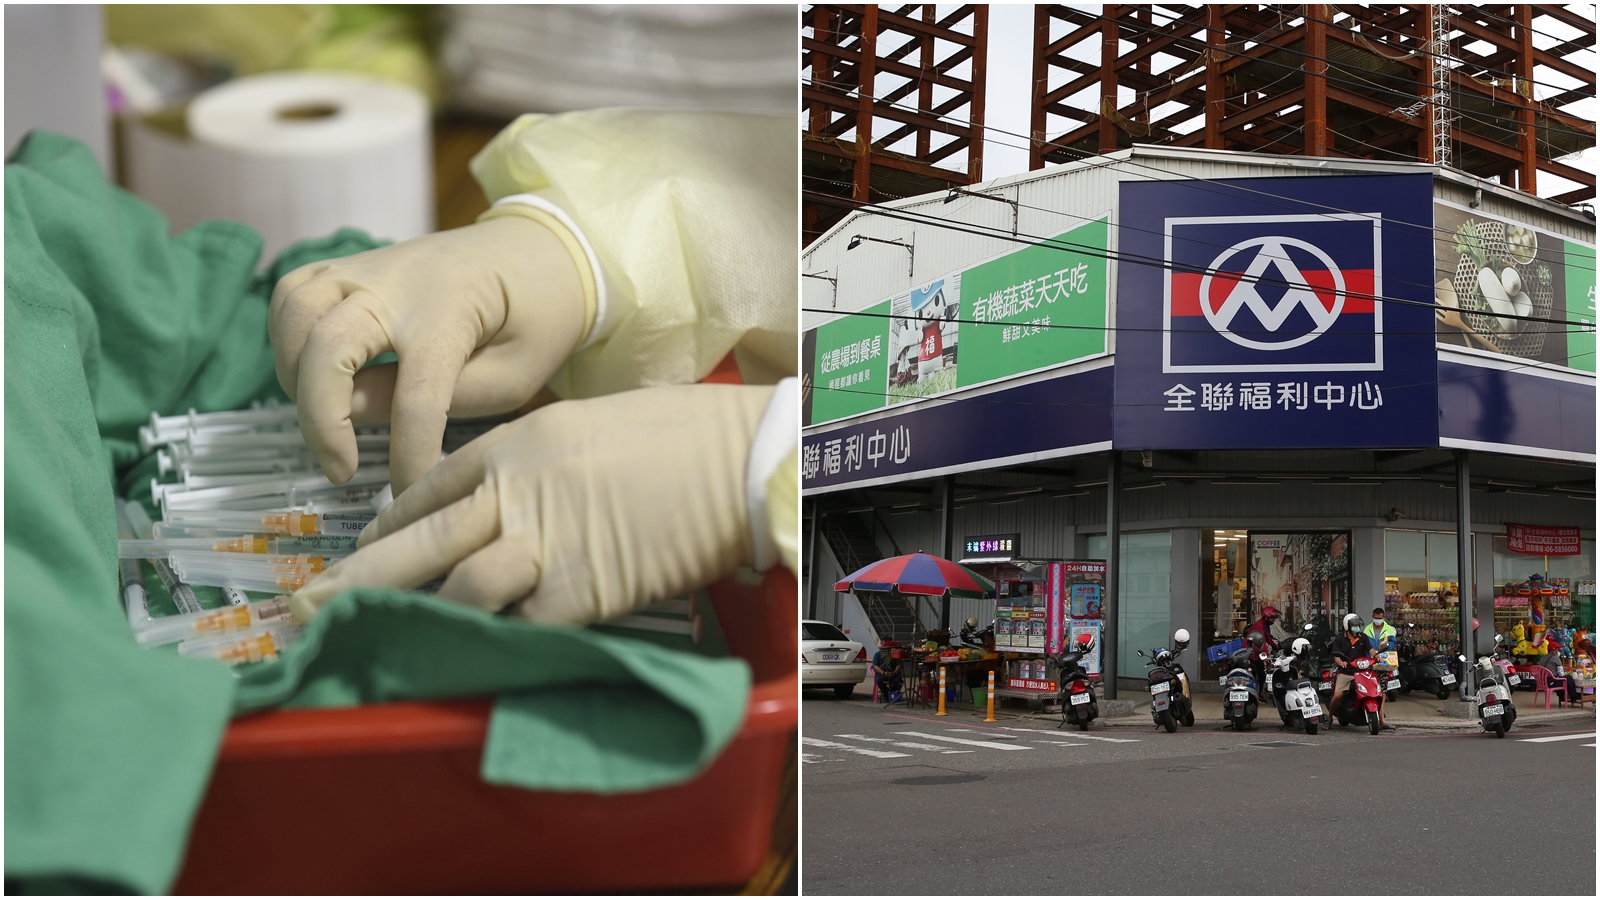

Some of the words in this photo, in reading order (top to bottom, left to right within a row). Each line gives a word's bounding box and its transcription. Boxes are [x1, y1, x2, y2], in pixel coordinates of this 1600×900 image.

[972, 262, 1089, 327] 有機蔬菜天天吃
[1002, 315, 1051, 344] 鮮甜又美味
[821, 334, 882, 374] 從農場到餐桌
[925, 335, 936, 356] 福
[1163, 381, 1384, 411] 全聯福利中心
[802, 424, 911, 479] 聯福利中心
[1067, 565, 1106, 573] 24H自助加水
